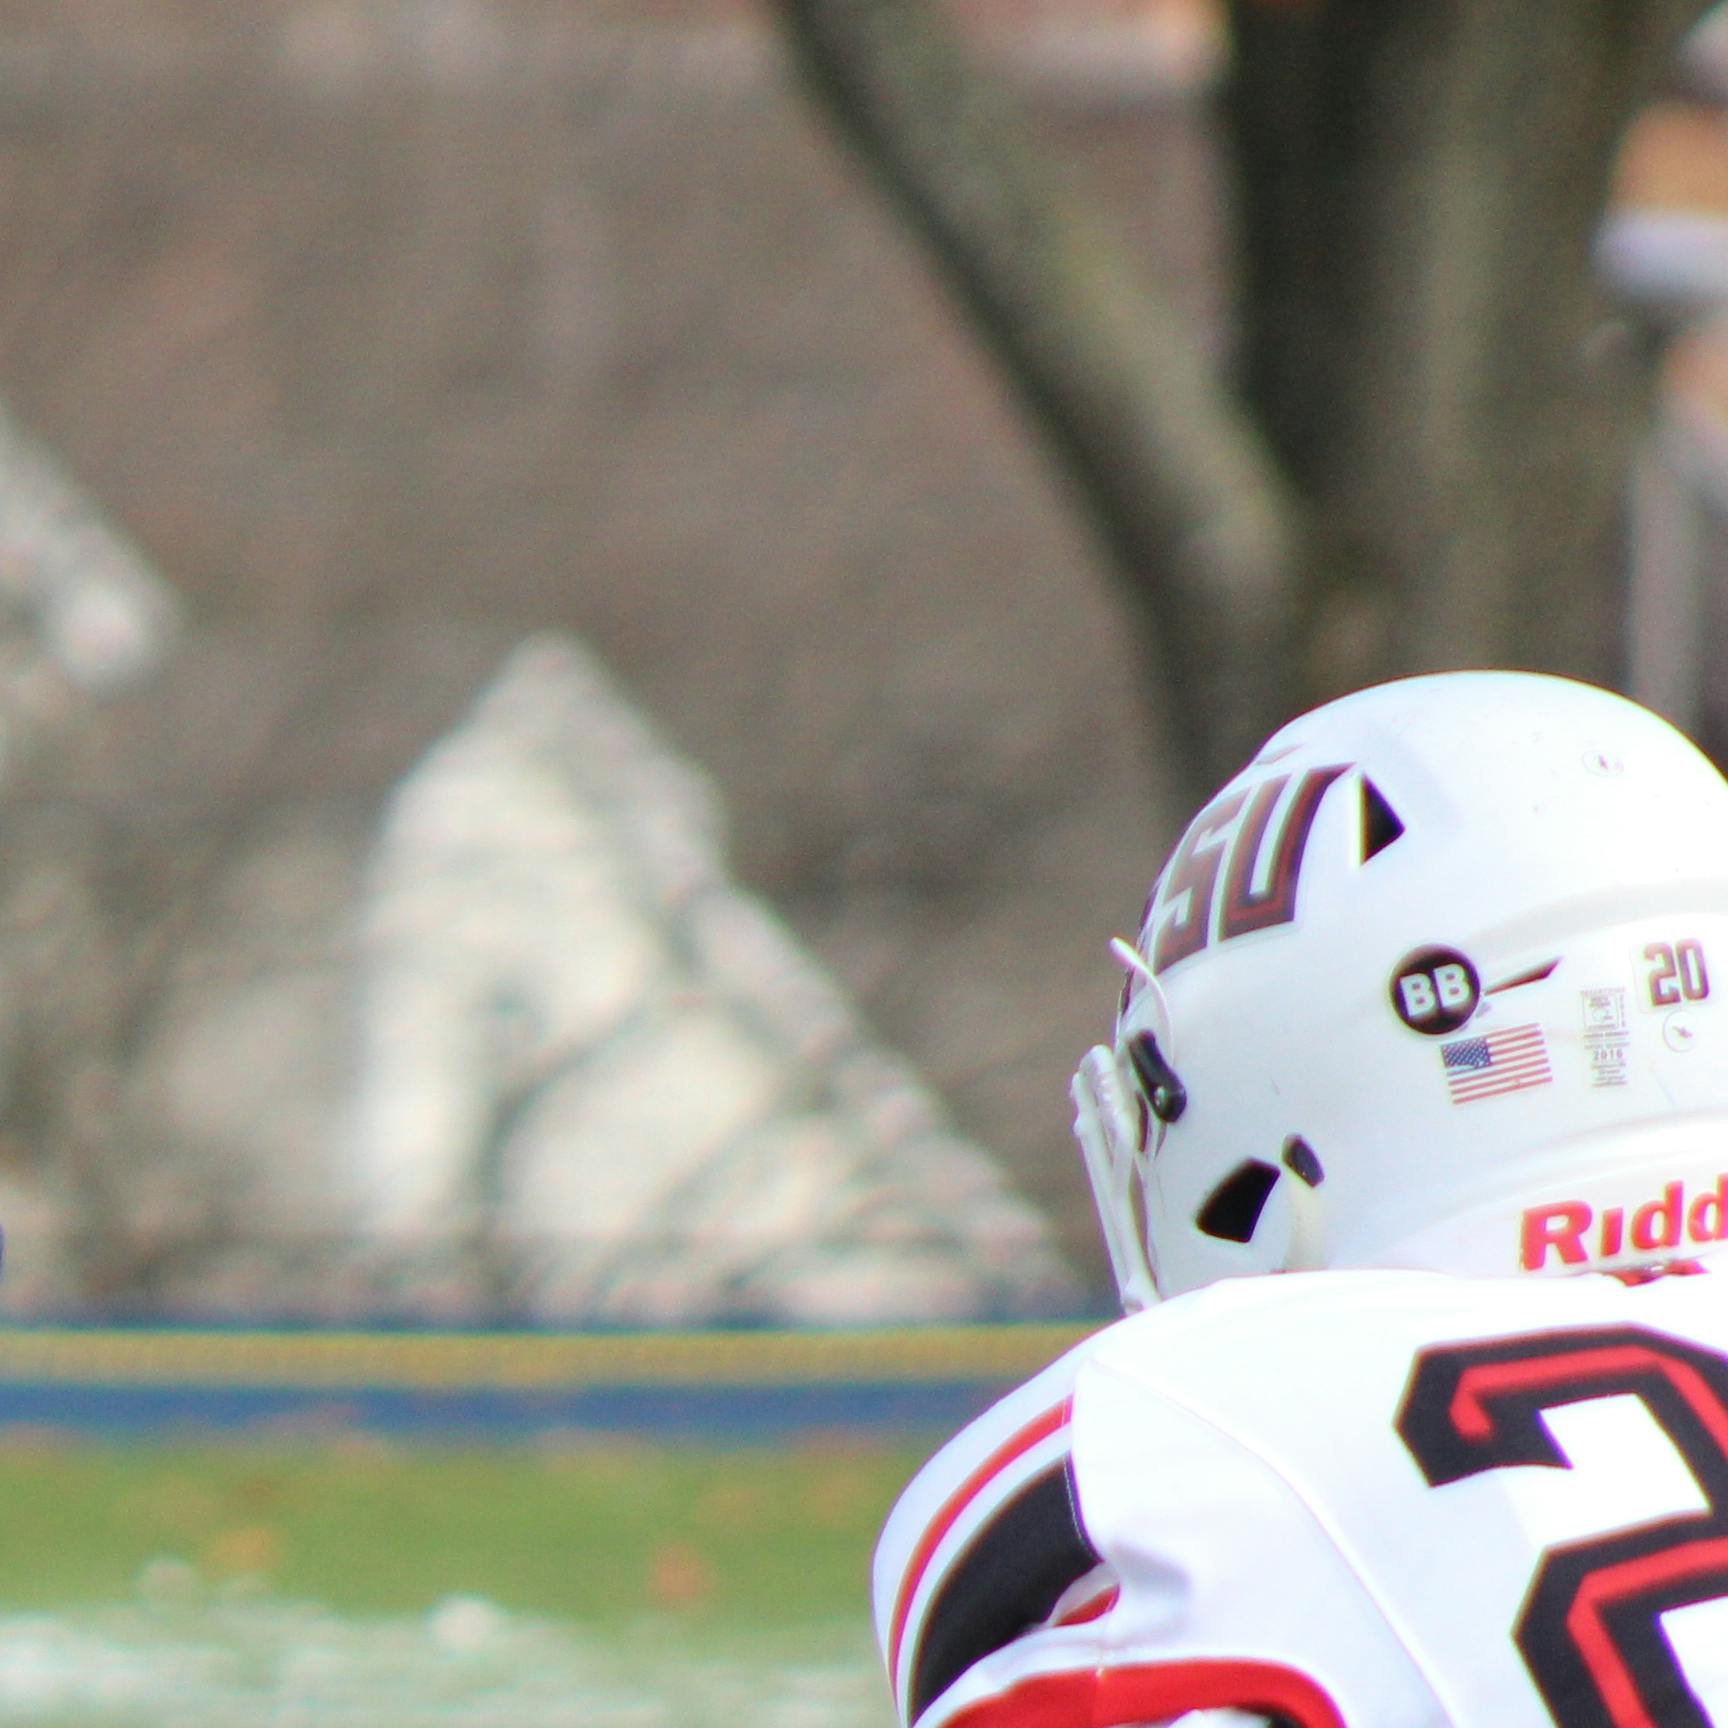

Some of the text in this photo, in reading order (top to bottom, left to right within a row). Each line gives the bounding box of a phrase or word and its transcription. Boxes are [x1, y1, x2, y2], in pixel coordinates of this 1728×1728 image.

[1132, 762, 1356, 995] SU
[1398, 962, 1472, 1019] BB
[1644, 938, 1711, 1007] 20
